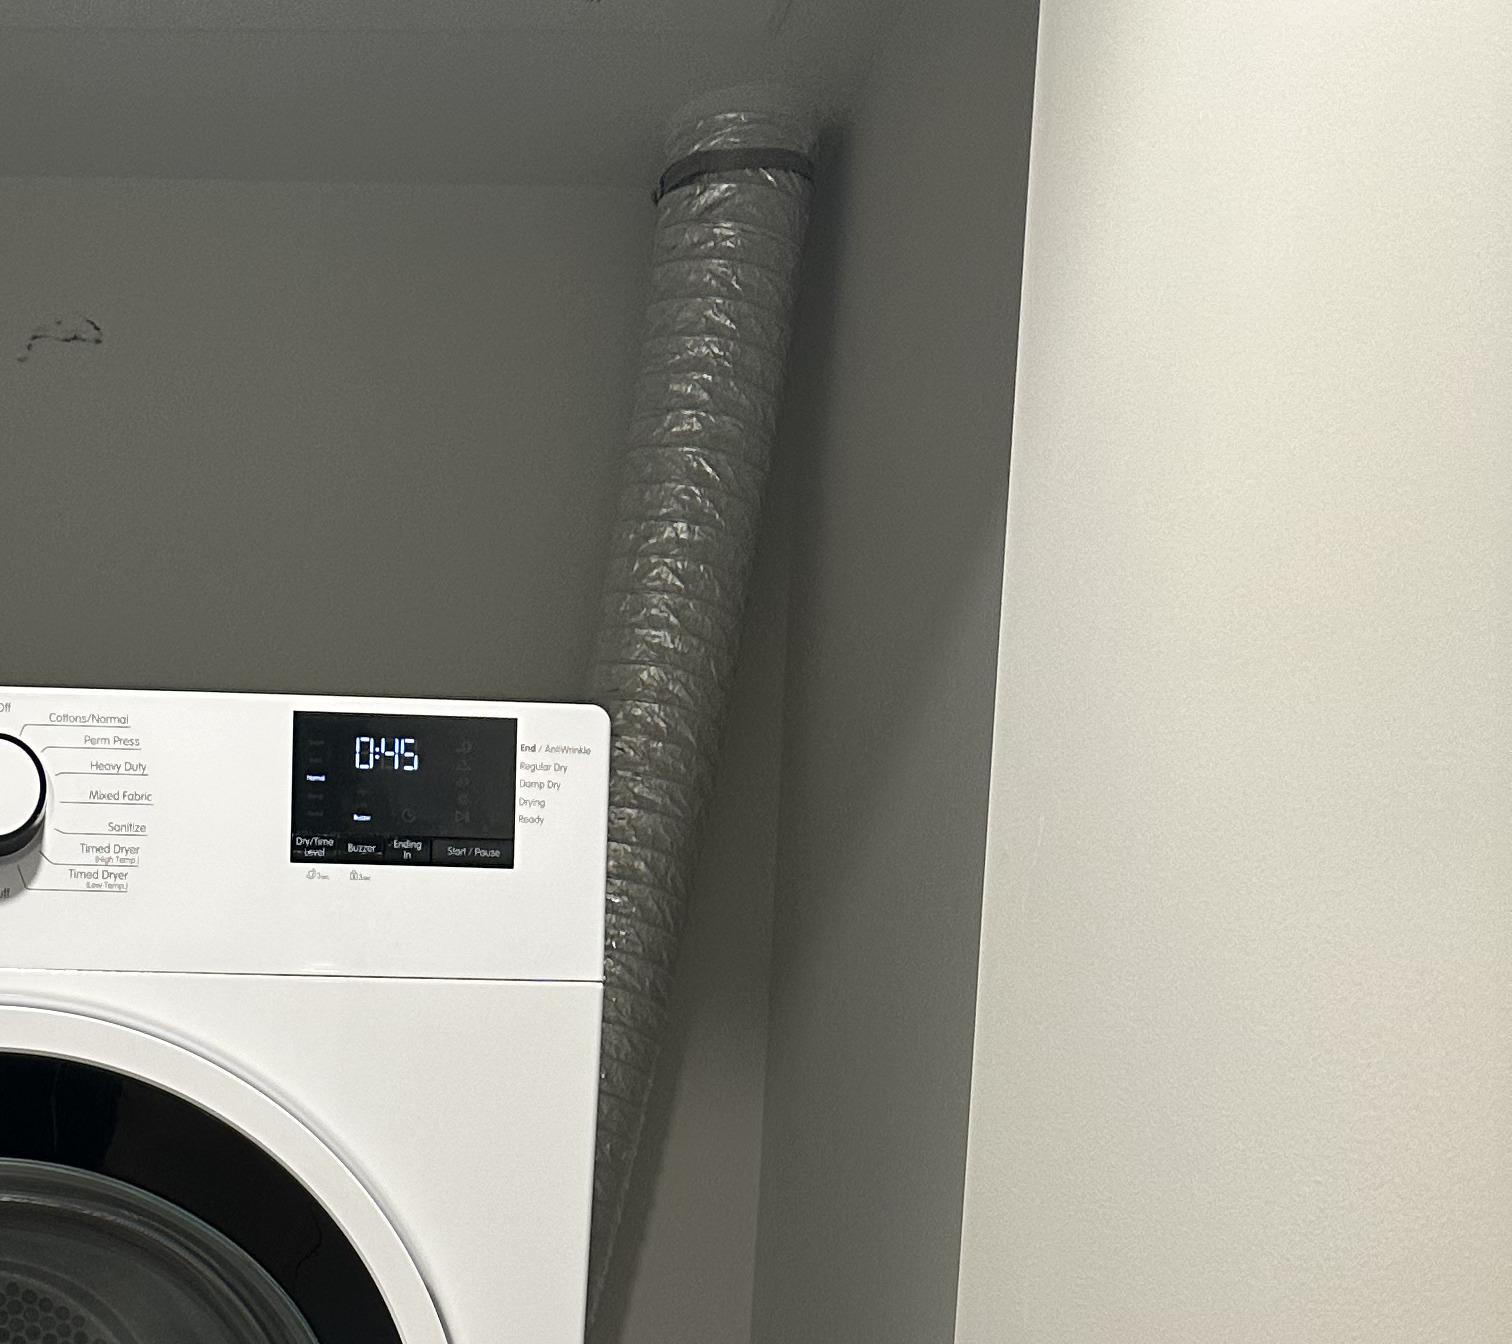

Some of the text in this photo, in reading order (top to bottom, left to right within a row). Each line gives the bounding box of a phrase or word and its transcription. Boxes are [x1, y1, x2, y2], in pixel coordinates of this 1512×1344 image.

[48, 712, 129, 725] Cottons/Normal
[84, 735, 140, 746] Perm Press
[355, 737, 419, 770] 0:45
[520, 744, 536, 753] End
[90, 761, 147, 774] Heavy Duty
[519, 761, 568, 774] Regular Dry
[519, 779, 561, 791] Damp Dry
[89, 790, 153, 802] Mixed Fabric
[518, 797, 546, 808] Drying
[518, 814, 544, 826] Ready
[107, 821, 147, 832] Sanitize
[295, 836, 335, 848] Dry/Time
[347, 843, 377, 853] Buzzer
[393, 840, 423, 851] Ending
[80, 843, 141, 856] Timed Dryer
[304, 848, 326, 858] Level
[403, 851, 412, 860] In
[447, 847, 467, 857] Start
[474, 848, 501, 858] Pause
[68, 869, 129, 882] Timed Dryer
